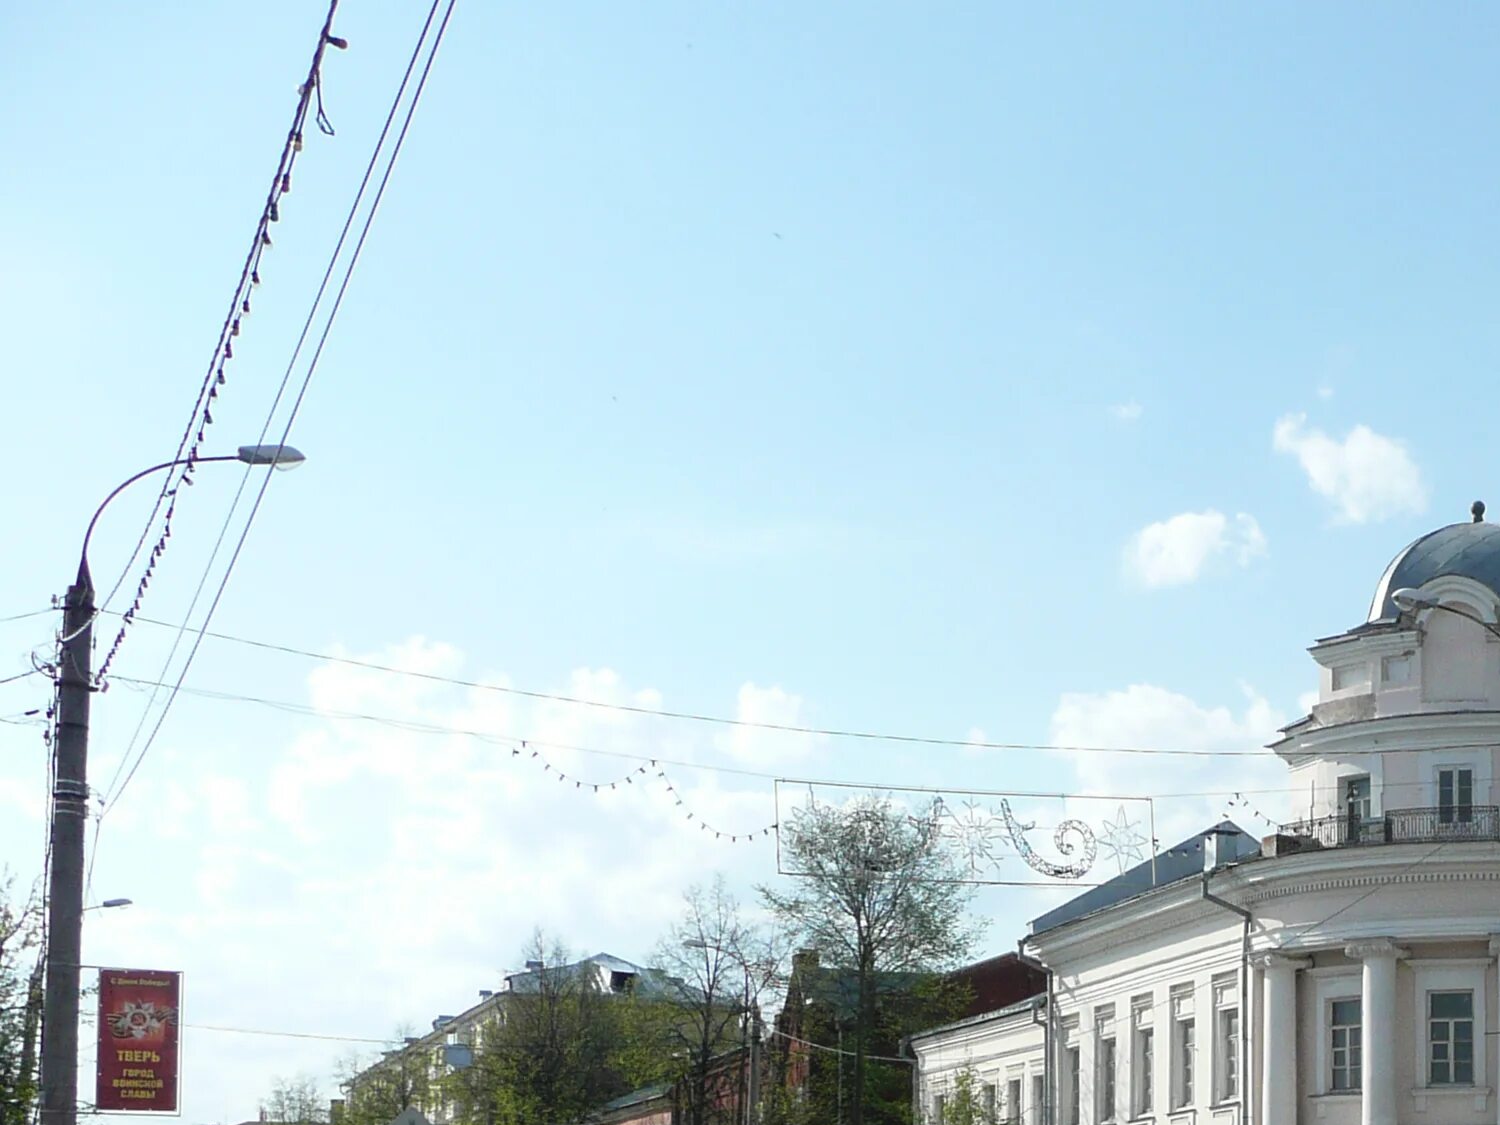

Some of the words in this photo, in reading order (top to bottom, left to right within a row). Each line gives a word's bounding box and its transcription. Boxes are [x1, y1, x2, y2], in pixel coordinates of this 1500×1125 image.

[117, 1049, 161, 1063] ТВЕРЬ
[122, 1068, 154, 1079] ГОРОД
[112, 1078, 164, 1089] ВОИНСКОЙ
